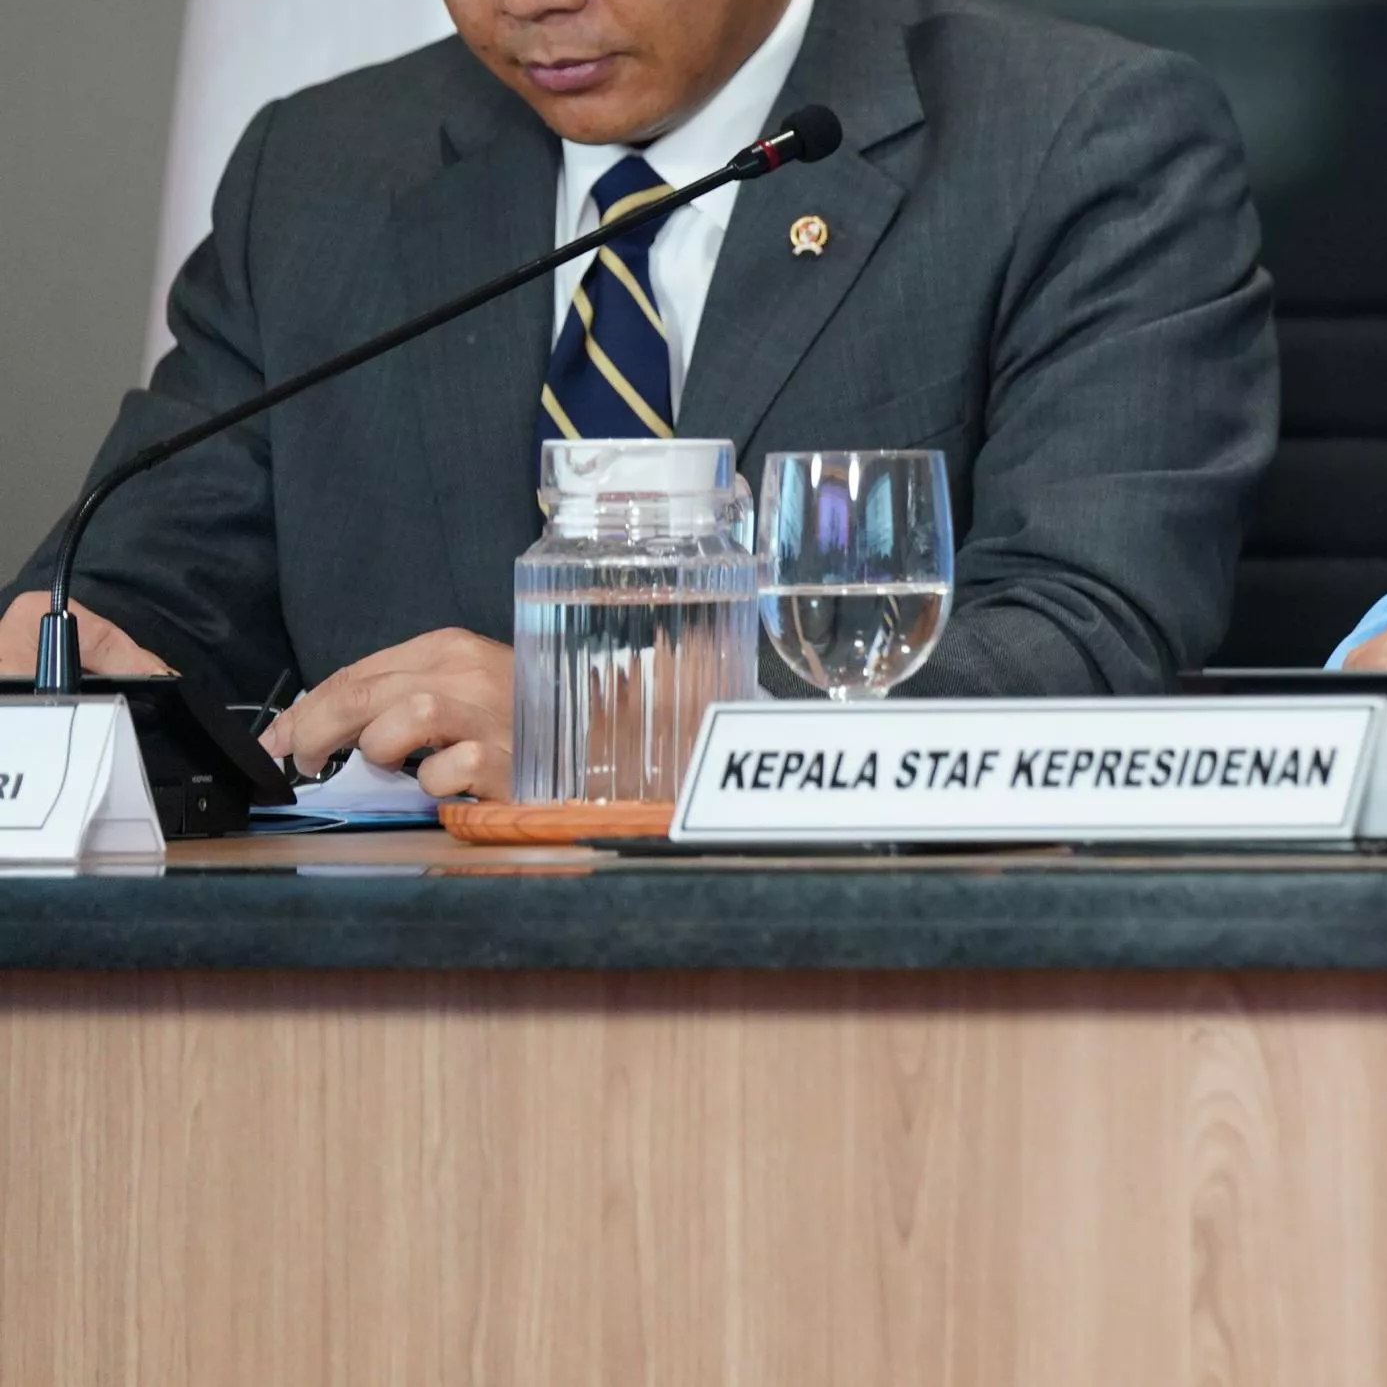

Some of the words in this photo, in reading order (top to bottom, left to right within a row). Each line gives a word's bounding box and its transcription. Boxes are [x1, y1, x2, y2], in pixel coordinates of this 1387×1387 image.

[719, 749, 878, 791] KEPALA
[894, 749, 1000, 790] STAF
[1009, 747, 1337, 789] KEPRESIDENAN
